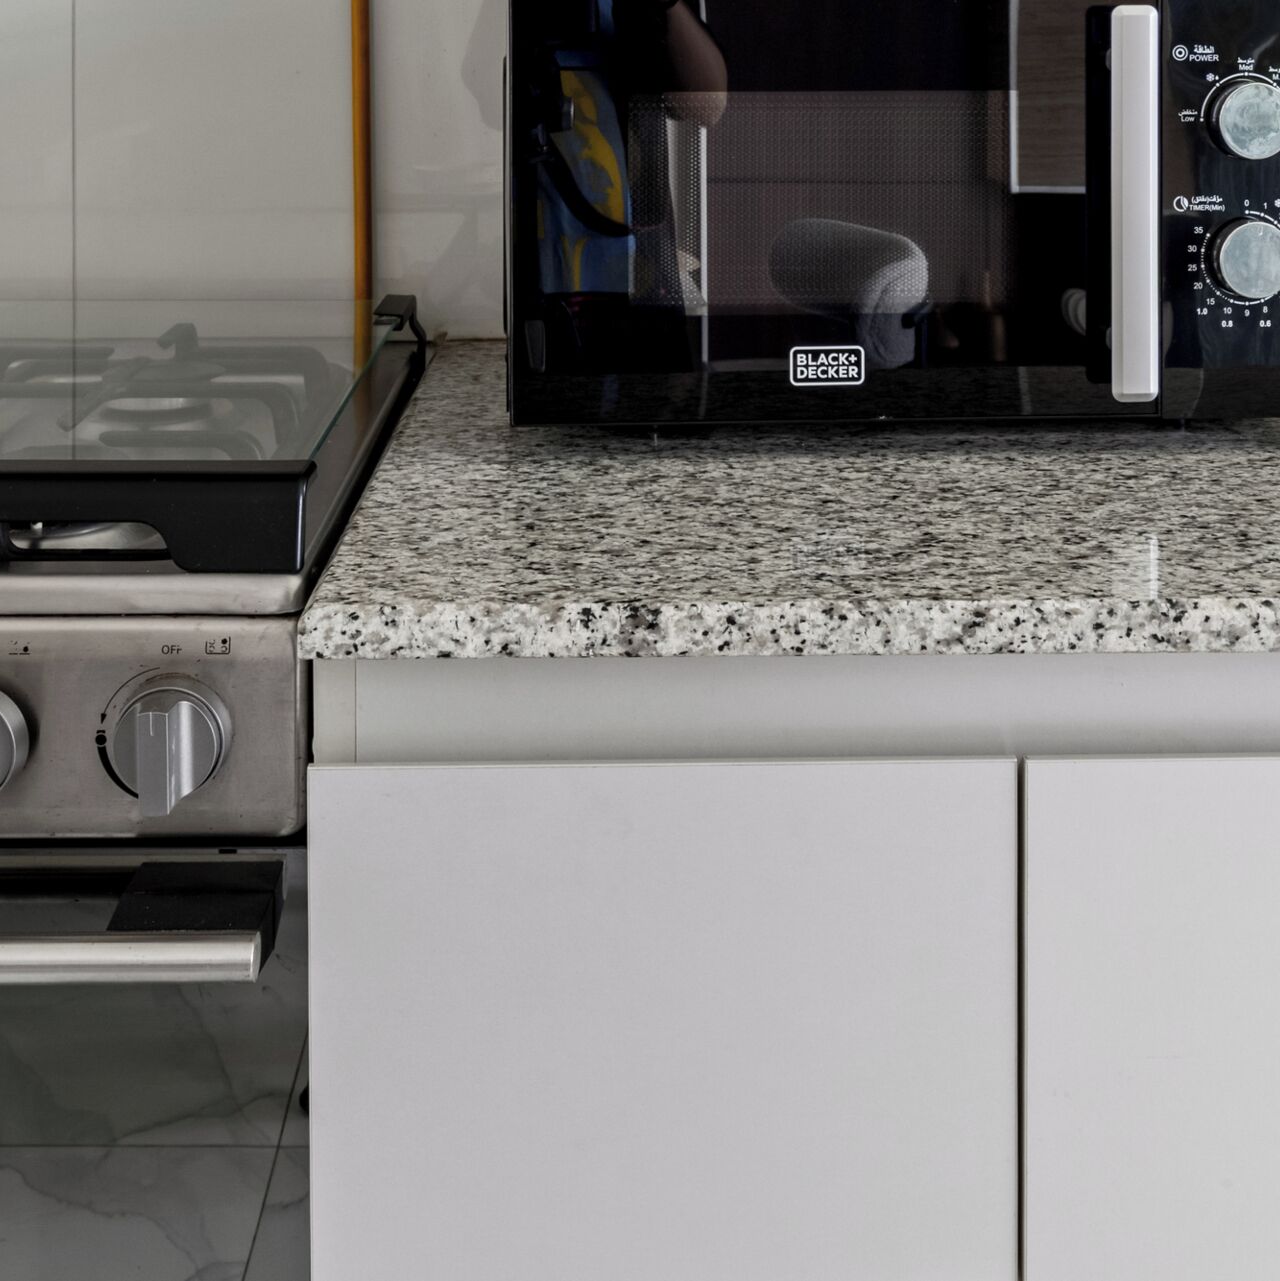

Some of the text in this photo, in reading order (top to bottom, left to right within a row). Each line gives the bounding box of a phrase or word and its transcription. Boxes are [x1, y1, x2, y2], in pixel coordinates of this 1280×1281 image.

[1189, 54, 1219, 62] POWER
[1244, 199, 1250, 207] 0
[1189, 204, 1225, 212] TIMER(Min)
[1193, 226, 1203, 234] 35
[1193, 282, 1203, 290] 20
[1244, 309, 1250, 317] 9
[796, 353, 858, 366] BLACK+
[796, 366, 859, 379] DECKER
[161, 644, 183, 655] OFF
